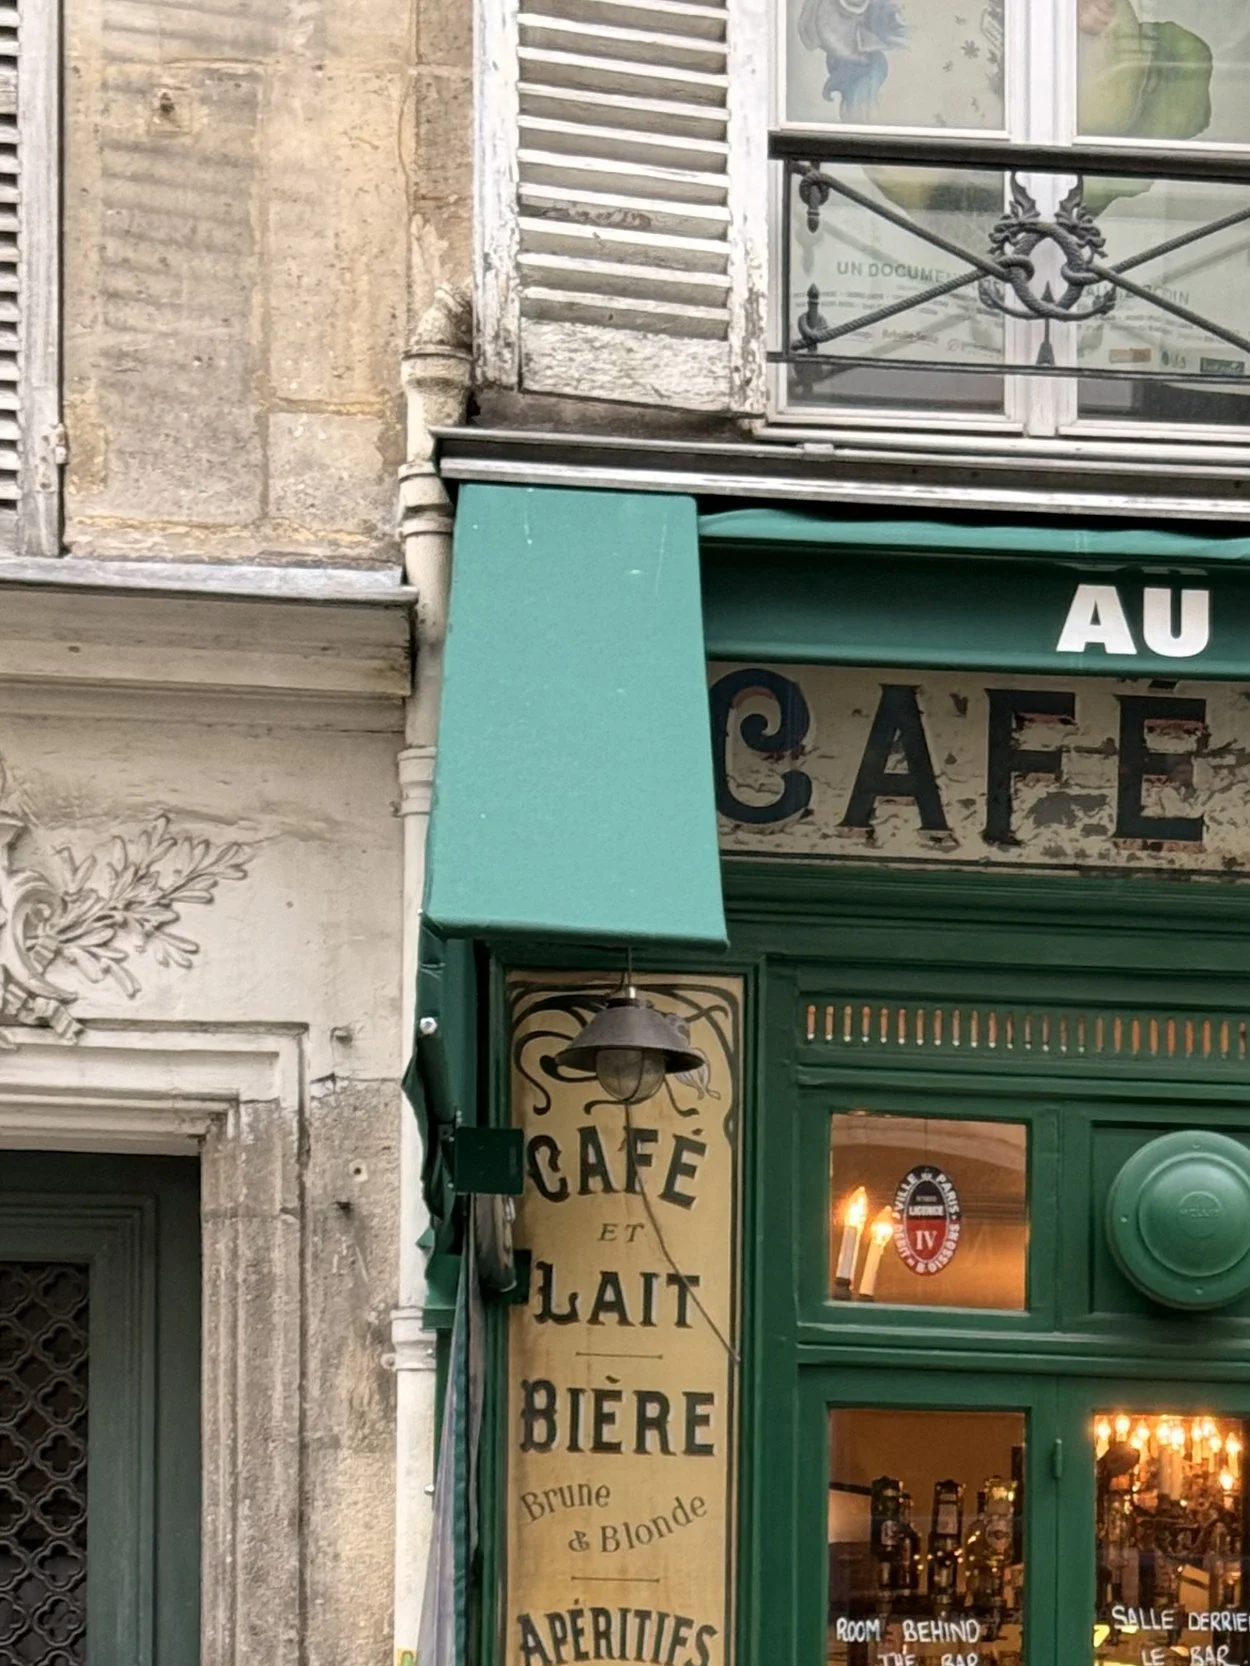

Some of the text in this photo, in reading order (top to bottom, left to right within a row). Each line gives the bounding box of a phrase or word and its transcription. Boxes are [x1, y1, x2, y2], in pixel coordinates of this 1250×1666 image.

[1056, 584, 1210, 657] AU
[526, 1124, 708, 1211] CAFÉ
[894, 1172, 917, 1211] VILLE
[936, 1173, 960, 1213] PARIS
[597, 1222, 645, 1243] ET
[915, 1230, 938, 1251] IV
[533, 1260, 700, 1329] LAIT
[519, 1375, 716, 1457] BIÈRE
[519, 1482, 612, 1523] Brune
[567, 1494, 708, 1553] & Blonde
[836, 1617, 880, 1643] ROOM
[1111, 1605, 1176, 1630] SALLE
[1141, 1647, 1166, 1666] LE
